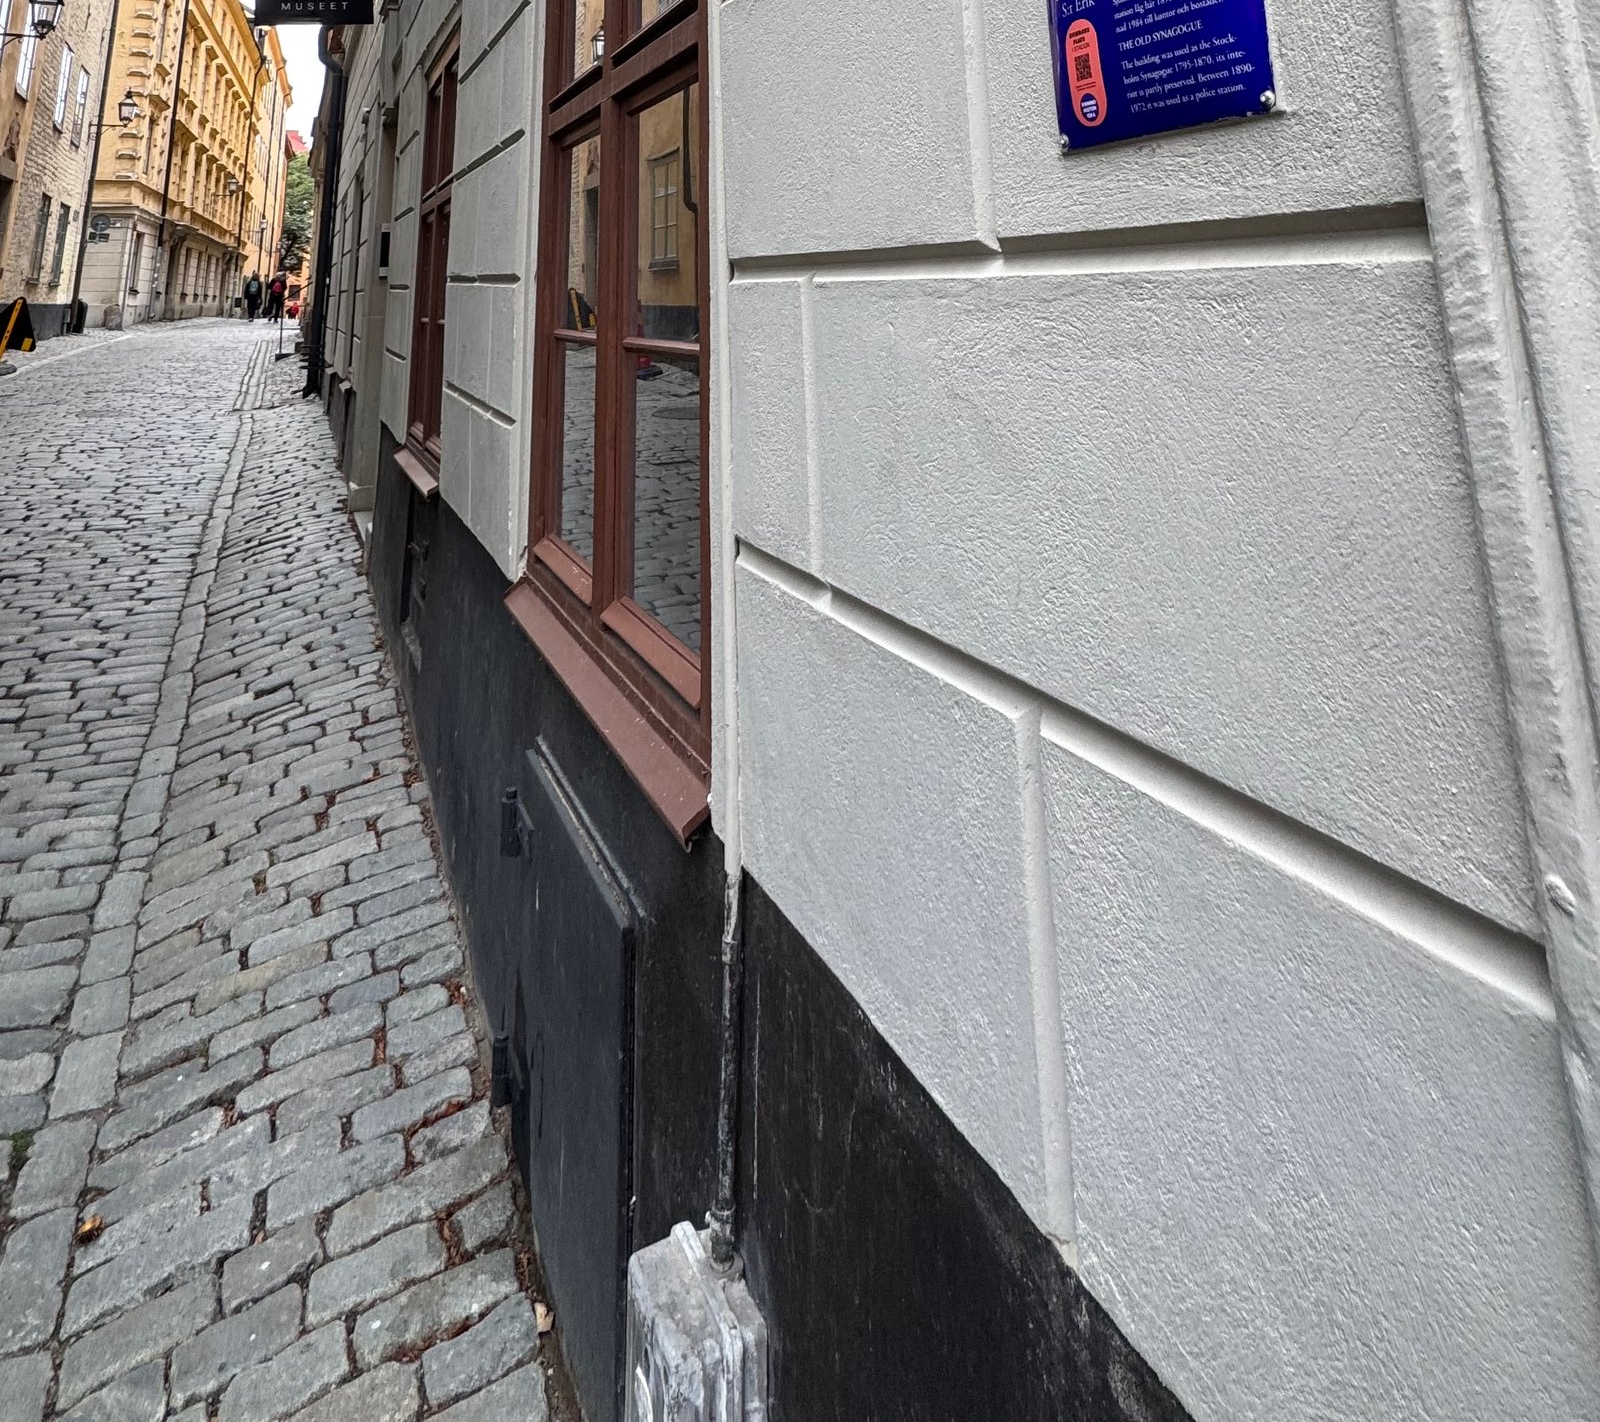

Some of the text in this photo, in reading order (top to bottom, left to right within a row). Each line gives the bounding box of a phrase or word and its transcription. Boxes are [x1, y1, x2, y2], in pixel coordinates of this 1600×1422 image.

[1062, 2, 1072, 17] S:t
[1116, 22, 1126, 33] nad
[1145, 14, 1153, 24] till
[1154, 9, 1175, 22] kontor
[1177, 5, 1189, 15] och
[1135, 3, 1144, 14] låg
[1145, 0, 1155, 9] här
[1118, 20, 1203, 51] THE OLD SYNAGOGUE
[1121, 60, 1133, 70] The
[1174, 44, 1189, 56] used
[1199, 39, 1210, 50] the
[1213, 34, 1237, 46] Stock-
[1124, 51, 1246, 85] holm Synagogue 1795-1870, its inte-
[1145, 83, 1162, 97] partly
[1164, 75, 1196, 92] preserved.
[1198, 70, 1228, 83] Between
[1231, 63, 1255, 75] 1890-
[1130, 102, 1146, 113] 1972
[1166, 94, 1181, 105] used
[1195, 88, 1216, 102] police
[1218, 83, 1246, 94] station.
